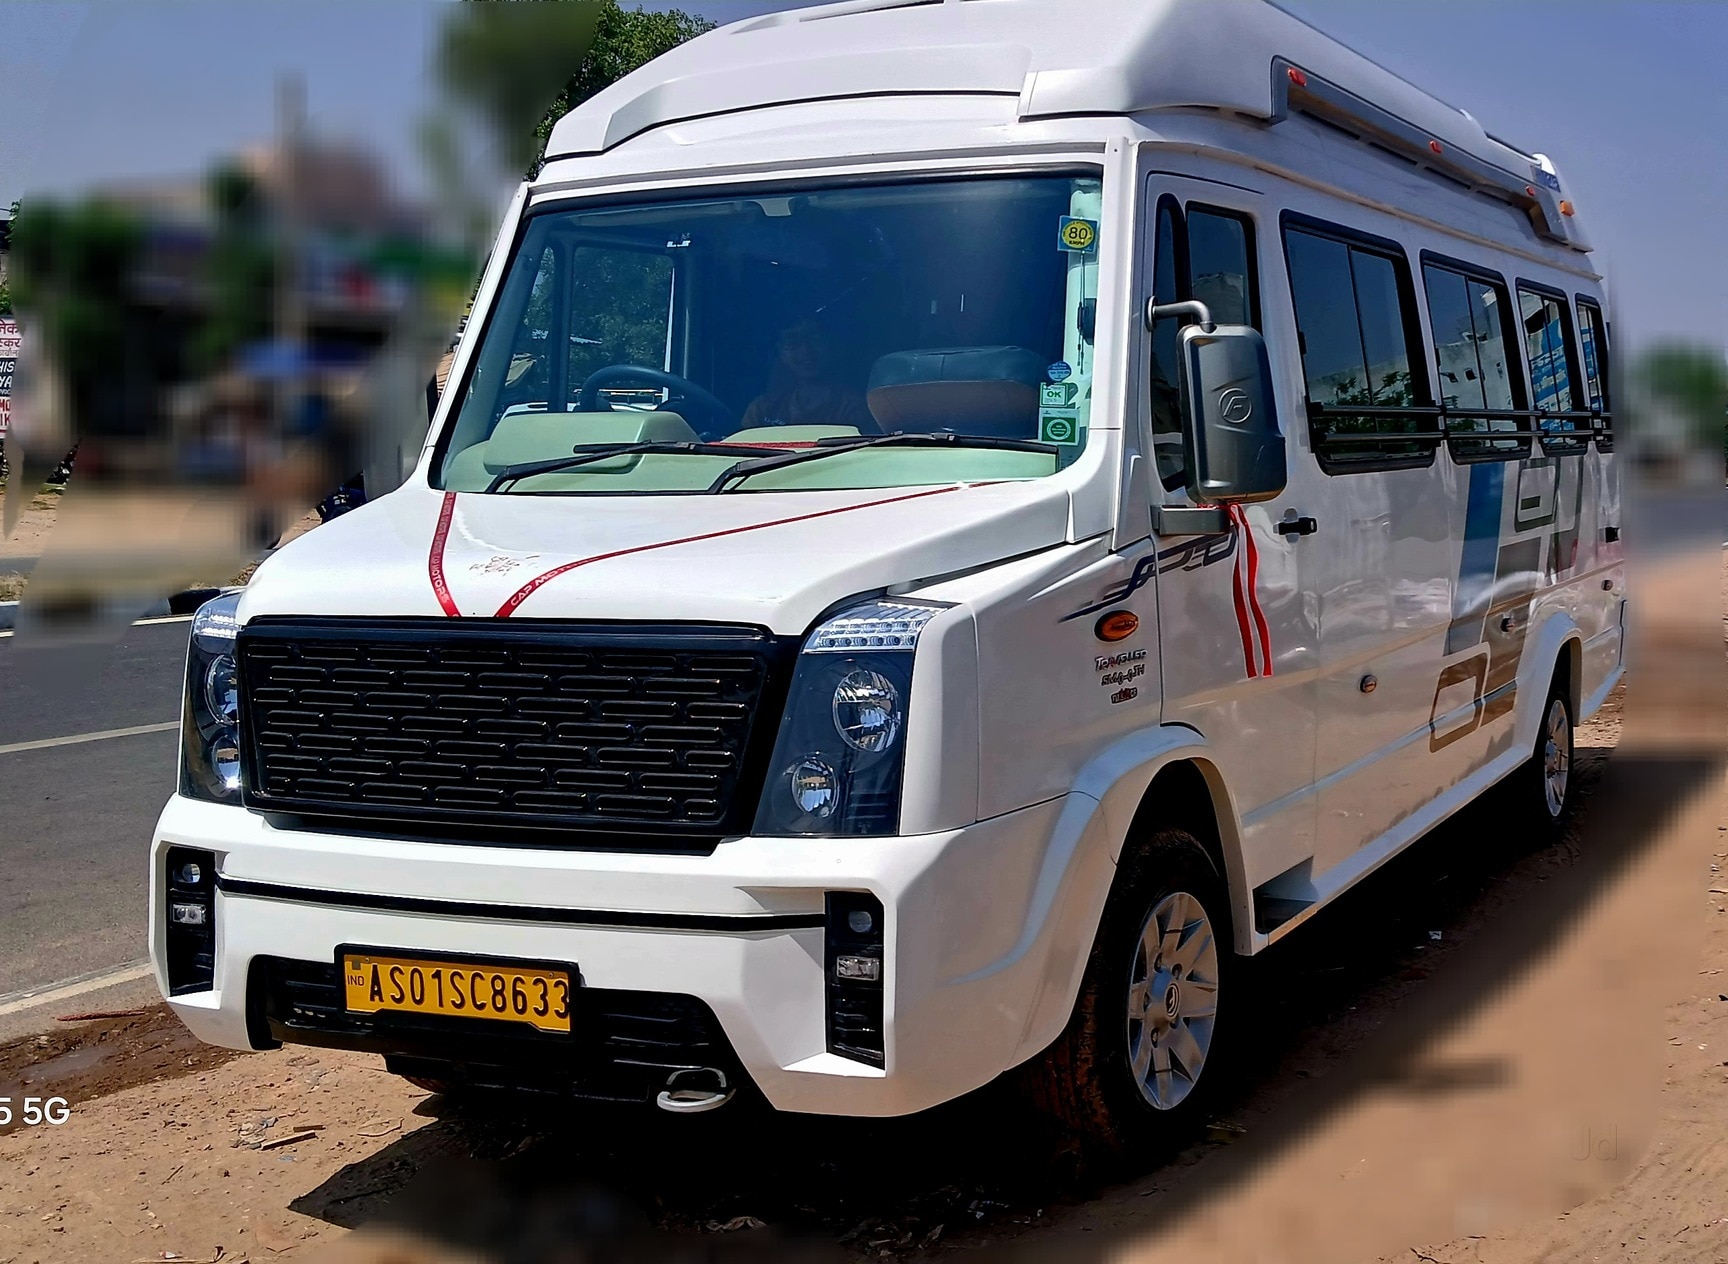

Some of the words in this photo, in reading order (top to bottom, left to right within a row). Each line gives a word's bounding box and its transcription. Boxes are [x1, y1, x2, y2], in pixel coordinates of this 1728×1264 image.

[1069, 226, 1088, 240] 80
[1046, 390, 1062, 398] OK
[510, 585, 532, 606] CAP
[347, 974, 365, 987] IND
[369, 963, 570, 1019] AS01SC8633
